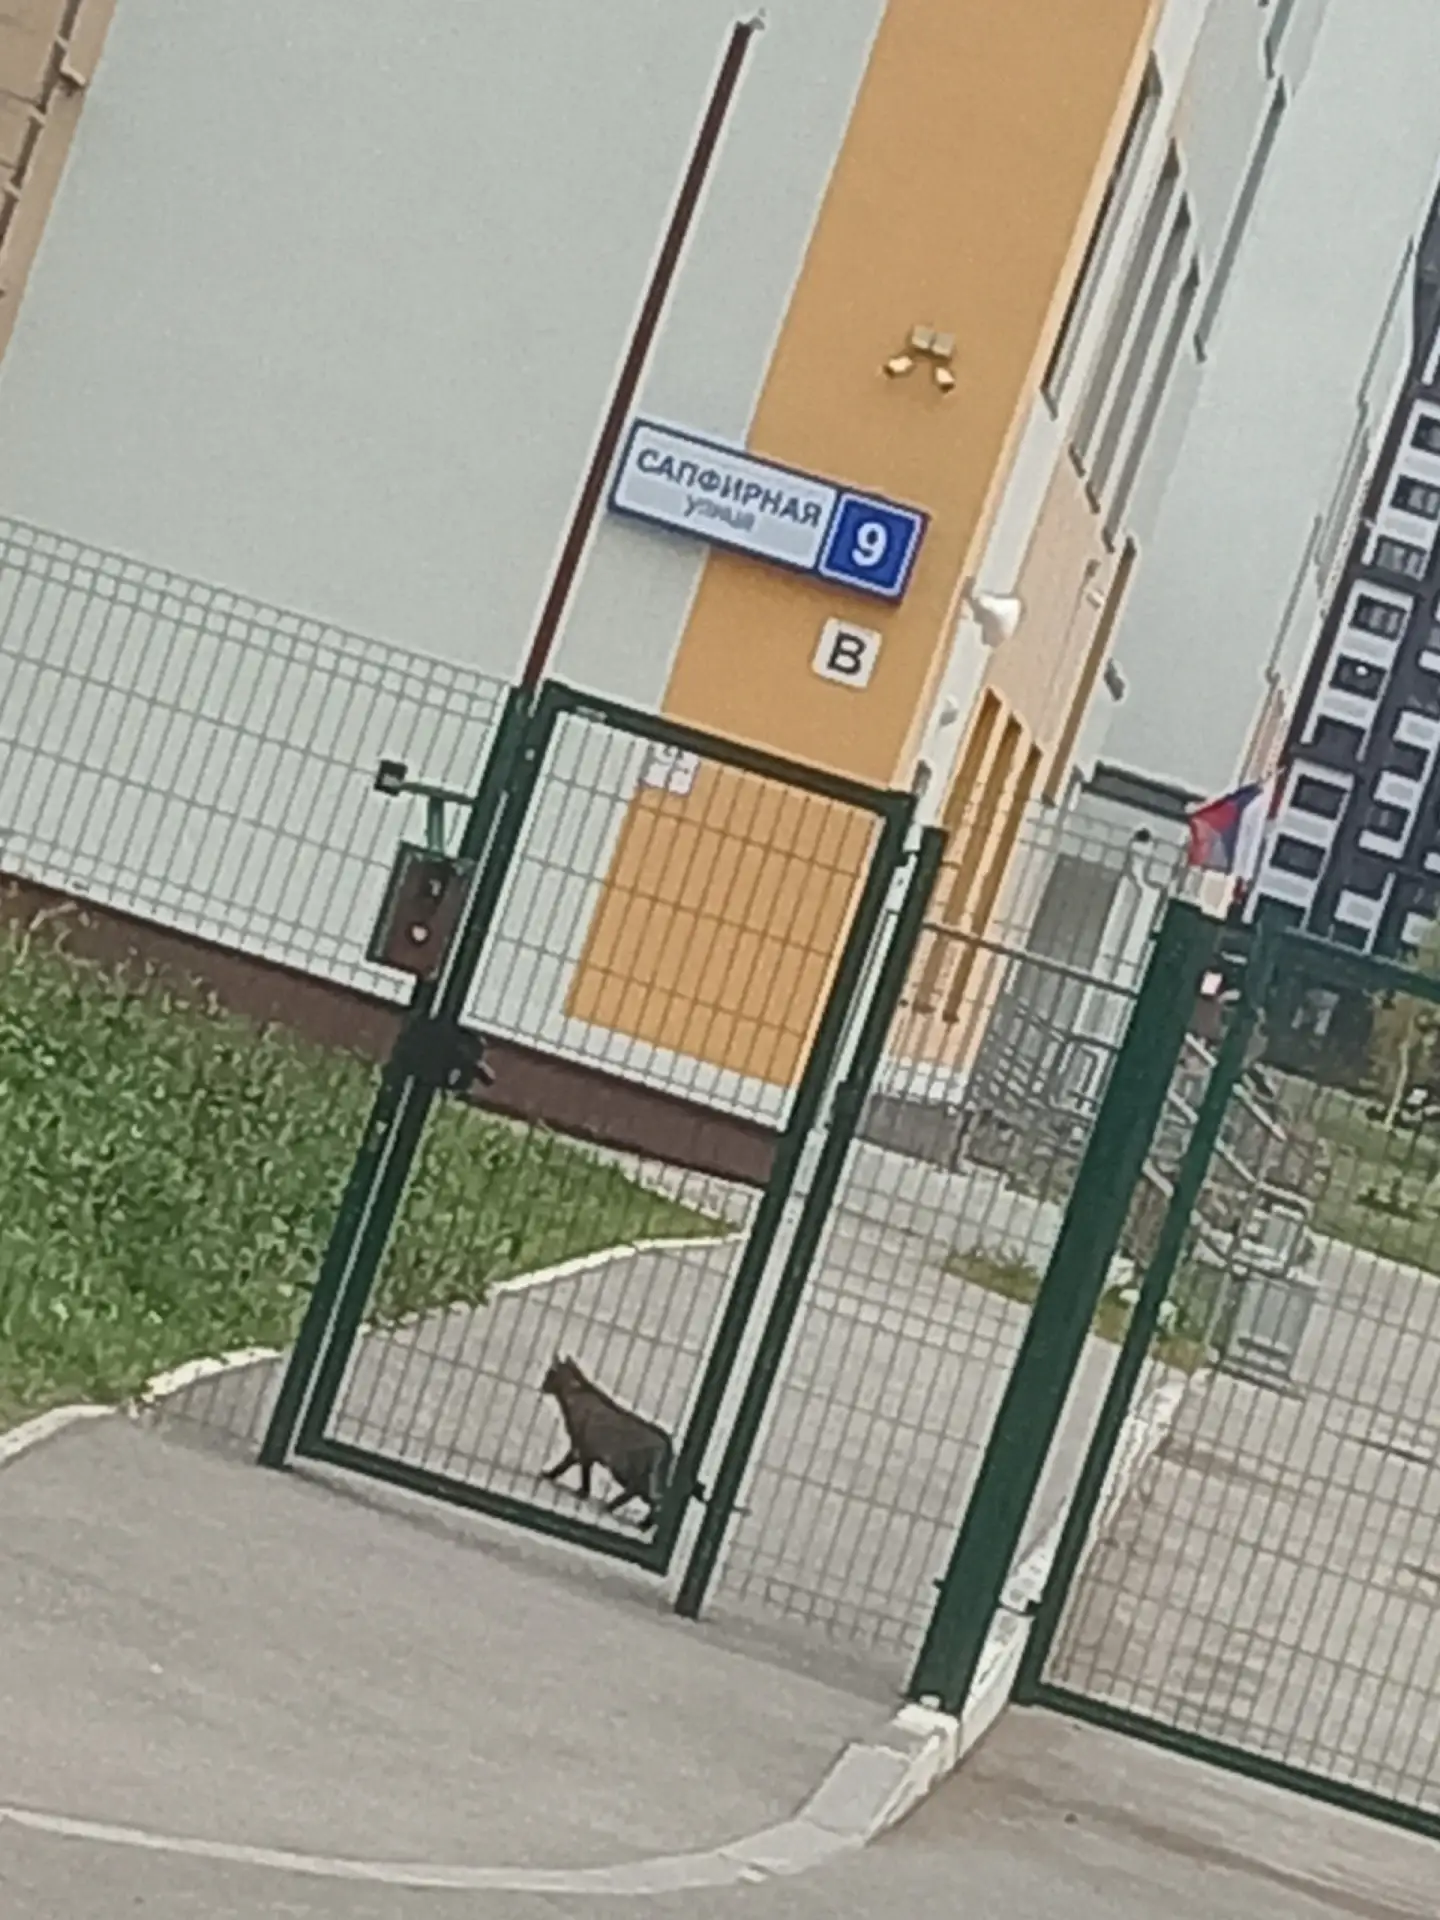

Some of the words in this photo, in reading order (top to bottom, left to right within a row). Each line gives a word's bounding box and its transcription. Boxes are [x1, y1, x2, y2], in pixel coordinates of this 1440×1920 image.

[637, 450, 822, 528] САПФИРНАЯ
[852, 522, 887, 566] 9
[827, 631, 867, 675] В
